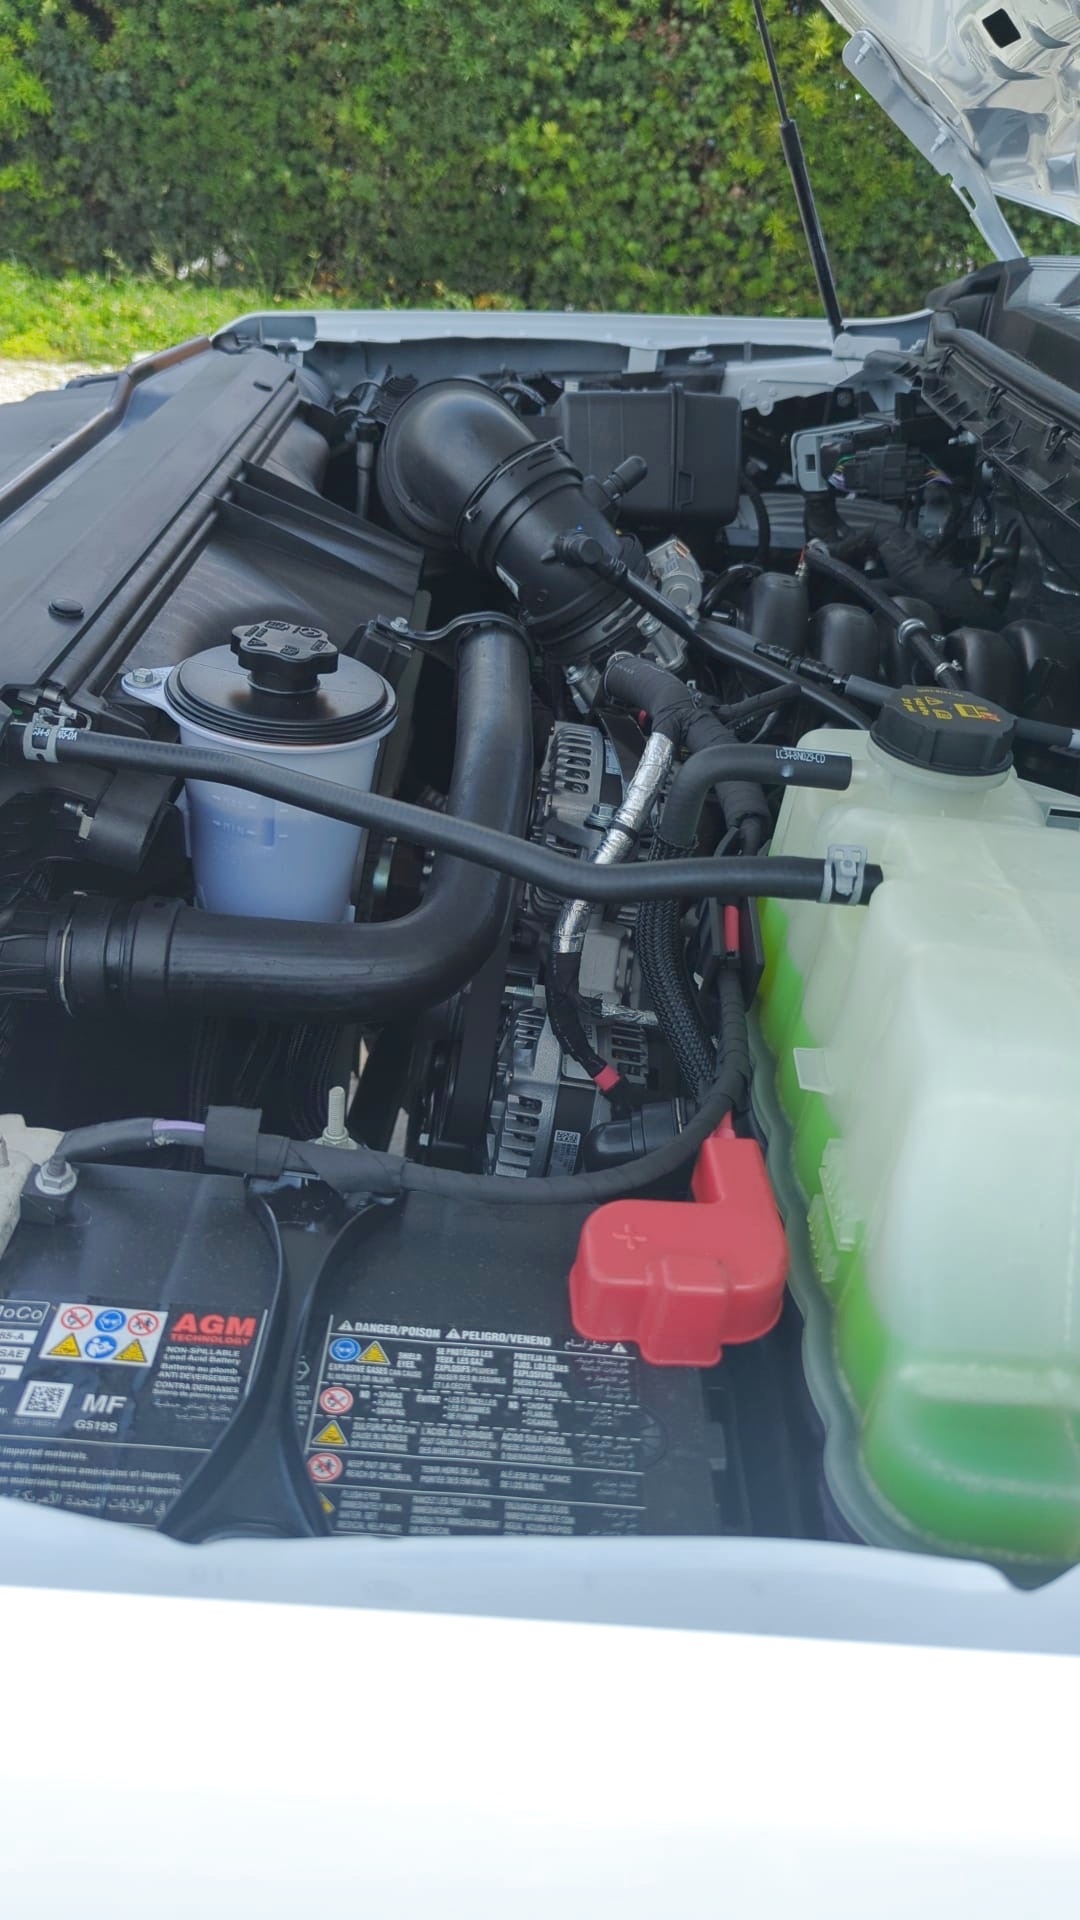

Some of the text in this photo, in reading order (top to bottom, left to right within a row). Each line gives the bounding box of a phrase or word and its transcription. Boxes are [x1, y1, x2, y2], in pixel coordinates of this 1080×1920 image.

[172, 1311, 257, 1337] AGM
[354, 1321, 441, 1338] DANGER/POISON
[170, 1333, 251, 1347] TECHNOLOGY
[461, 1330, 552, 1346] PELIGRO/VENENO
[165, 1346, 240, 1357] NON-SPILLABLE
[187, 1354, 208, 1362] Acid
[160, 1362, 195, 1371] Batterie
[155, 1380, 240, 1395] CONTRA DERRAMES
[81, 1393, 128, 1414] MF
[74, 1419, 118, 1433] G519S
